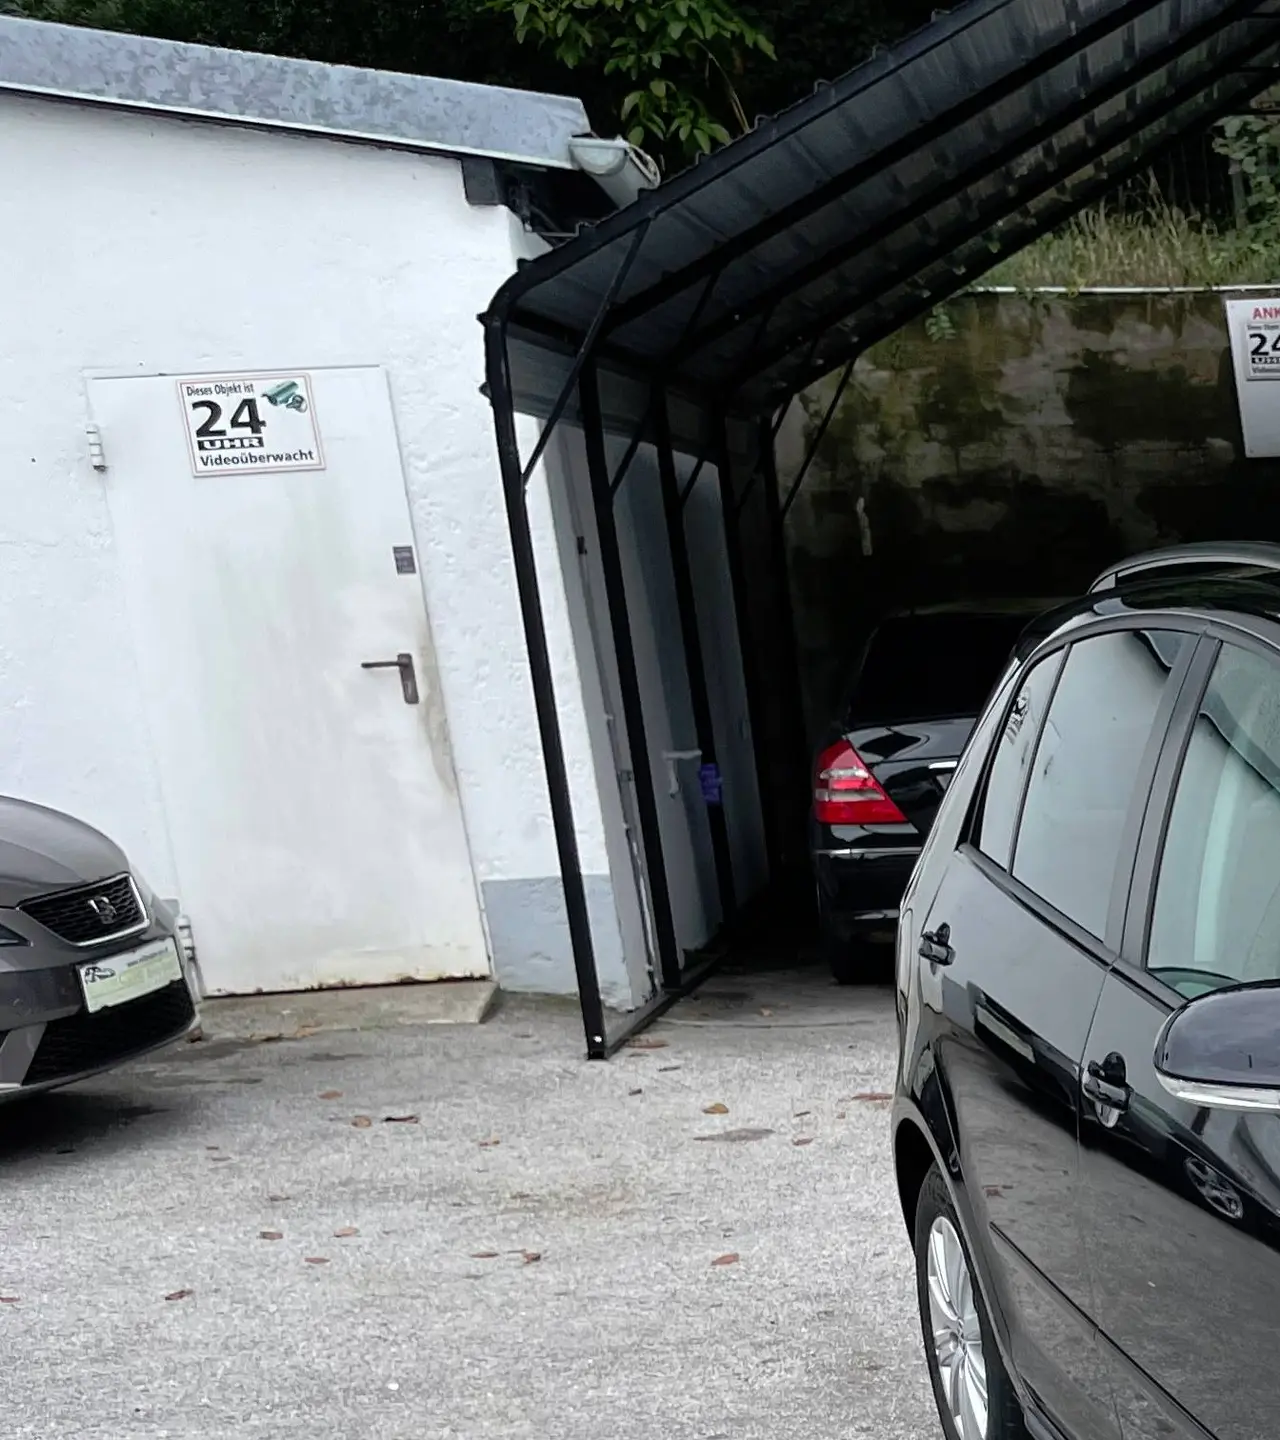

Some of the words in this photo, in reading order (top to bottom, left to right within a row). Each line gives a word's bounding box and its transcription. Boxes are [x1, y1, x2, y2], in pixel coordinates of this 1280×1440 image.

[186, 385, 213, 397] Dieses
[214, 384, 242, 397] Objekt
[243, 383, 255, 394] ist
[191, 397, 267, 438] 24
[203, 437, 260, 450] UHR
[200, 449, 315, 467] Videoüberwacht
